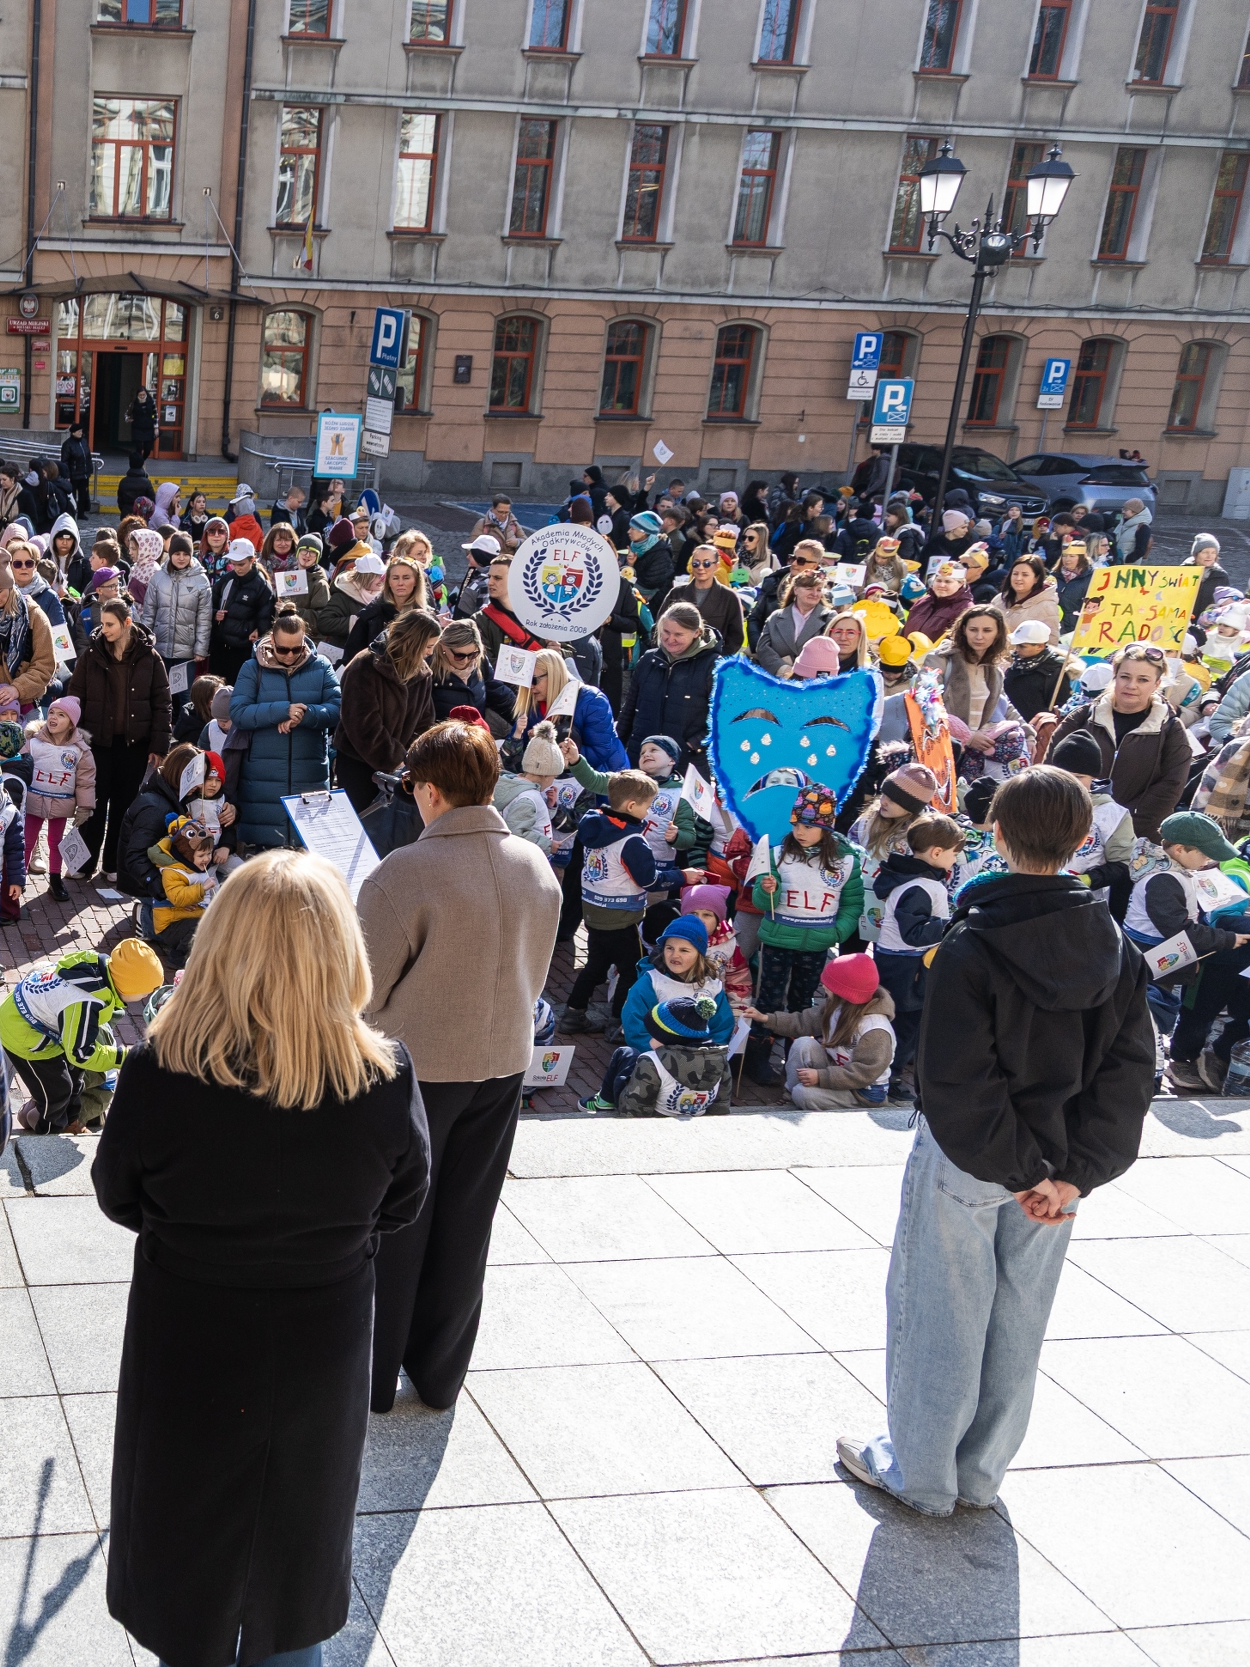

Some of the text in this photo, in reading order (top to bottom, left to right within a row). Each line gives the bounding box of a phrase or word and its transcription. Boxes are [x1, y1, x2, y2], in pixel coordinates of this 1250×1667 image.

[376, 314, 397, 358] P
[859, 336, 877, 359] P
[1048, 362, 1066, 383] P
[882, 385, 905, 413] P
[531, 529, 604, 553] Akademia Młodych
[542, 537, 592, 552] Odkrywców
[553, 549, 581, 562] ELF
[1111, 603, 1134, 617] TA
[525, 619, 588, 634] Rok założenia 2008
[36, 770, 71, 786] ELF
[786, 890, 836, 912] ELF
[546, 1074, 558, 1082] ELF
